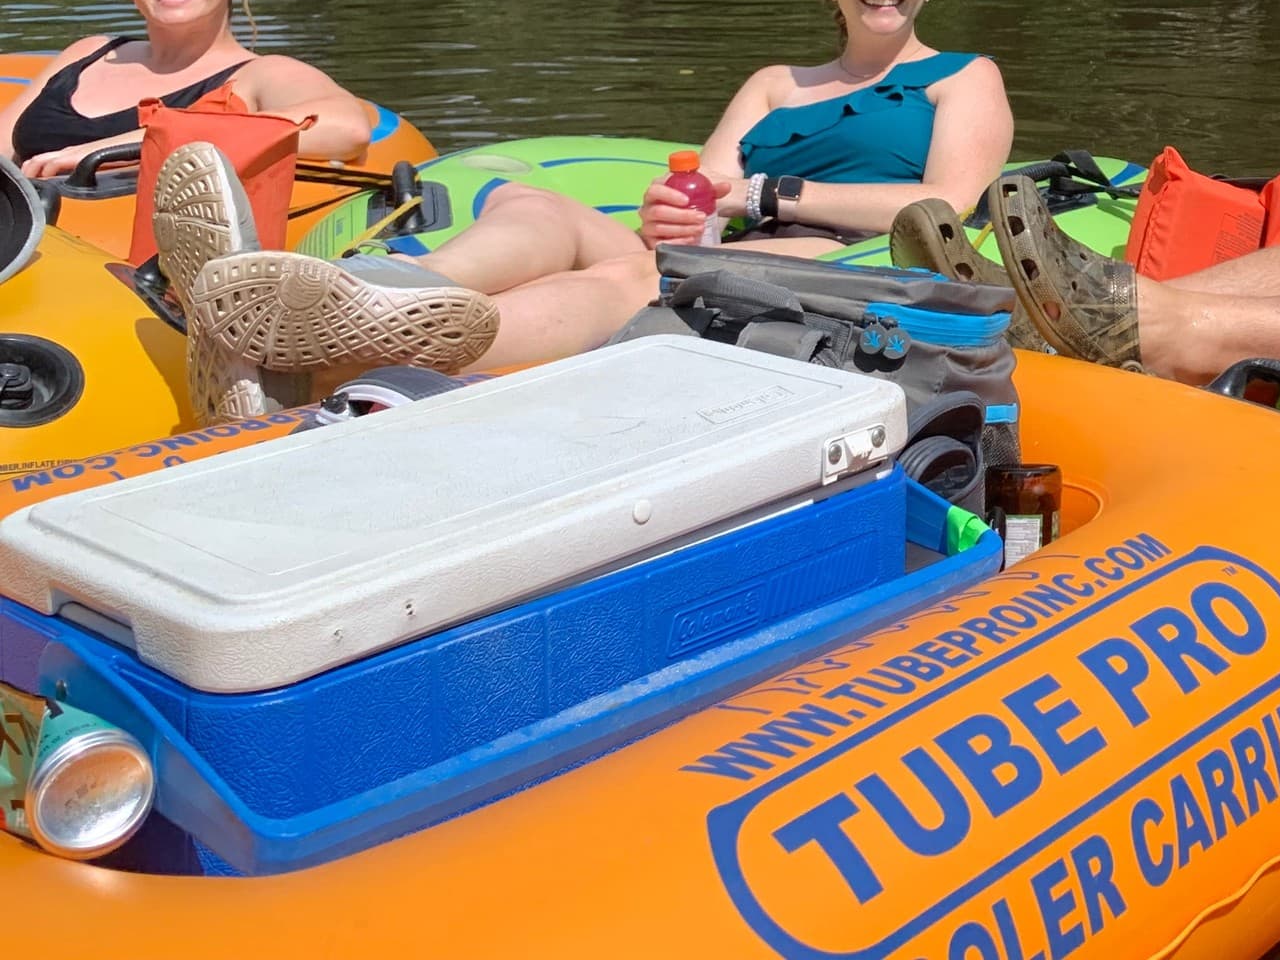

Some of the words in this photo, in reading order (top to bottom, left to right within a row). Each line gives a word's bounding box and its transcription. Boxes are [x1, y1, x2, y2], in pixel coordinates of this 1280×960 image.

[679, 533, 1172, 781] WWW.TUBEPROINC.COM
[771, 674, 1108, 906] TUBE
[1076, 582, 1267, 728] PRO
